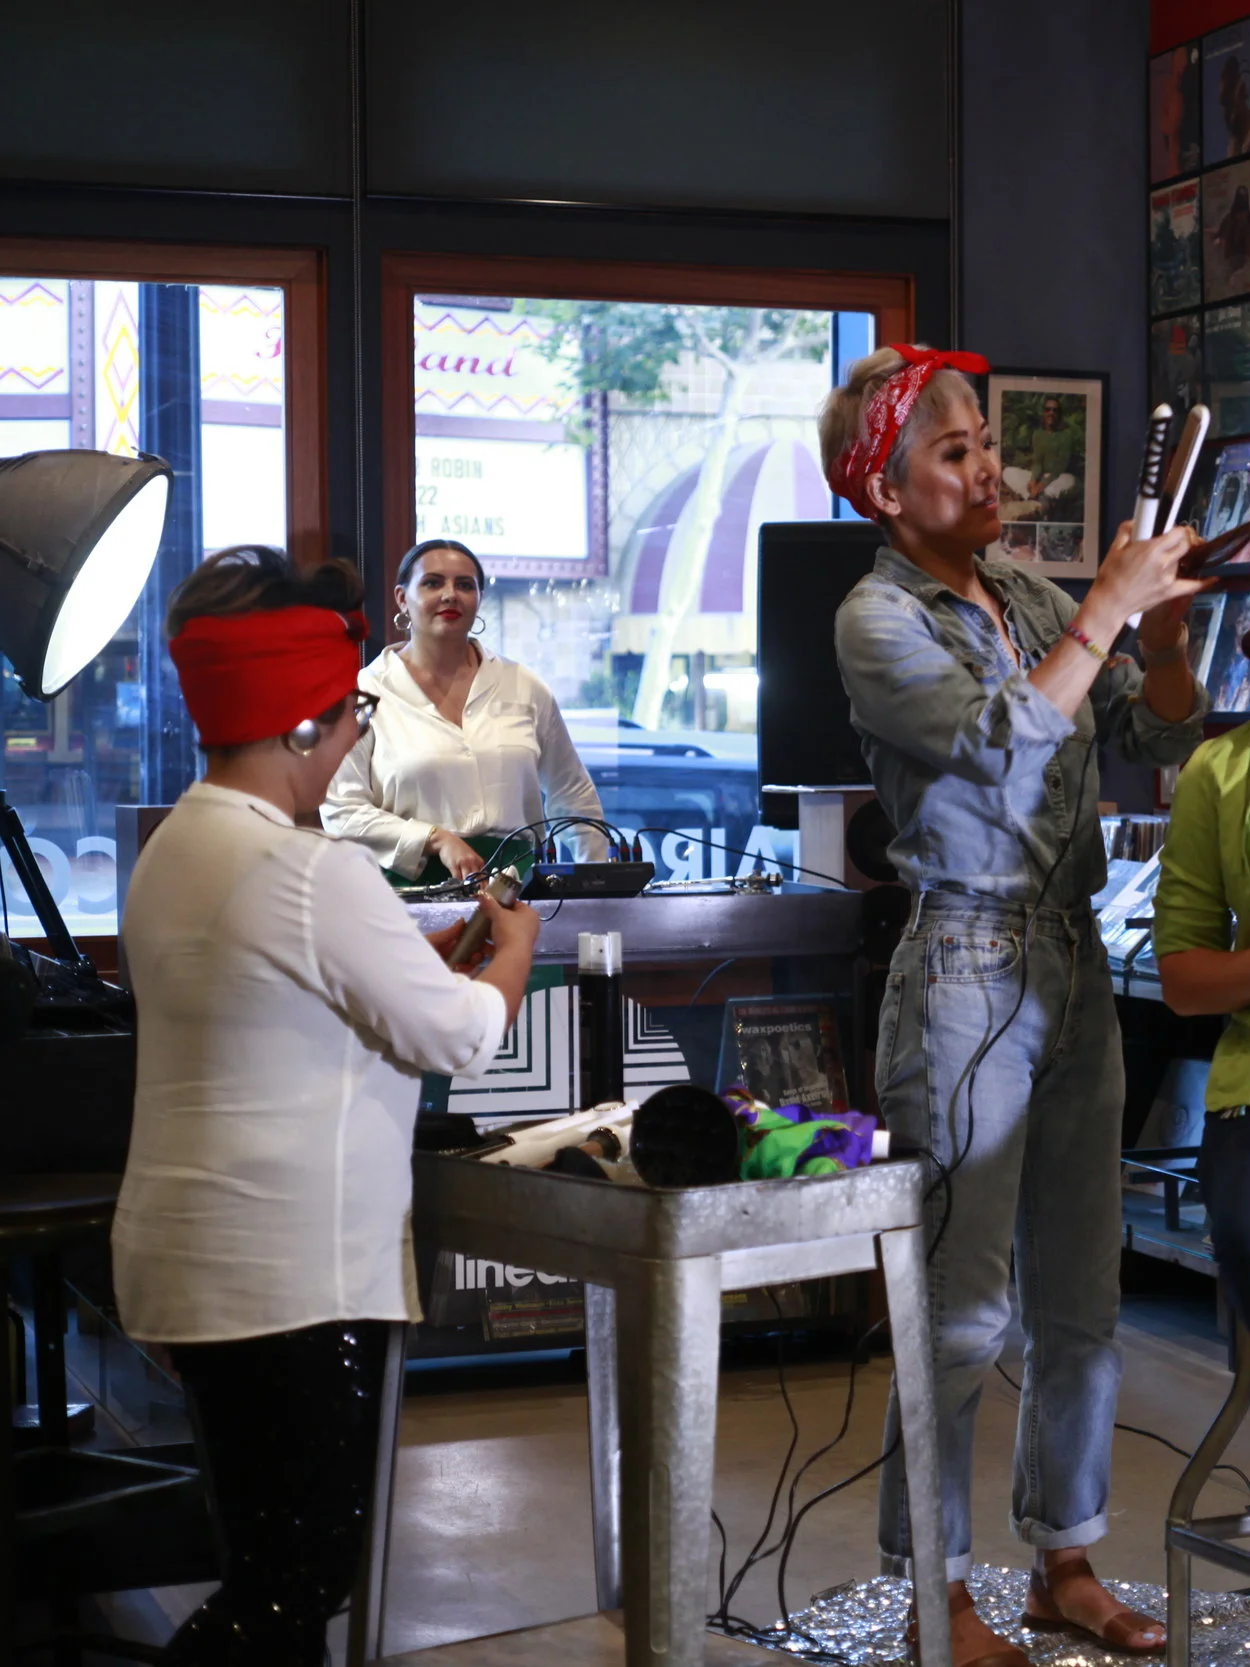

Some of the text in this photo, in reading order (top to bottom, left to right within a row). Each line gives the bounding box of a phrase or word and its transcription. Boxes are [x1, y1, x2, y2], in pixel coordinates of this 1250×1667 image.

[431, 458, 483, 479] ROBIN
[441, 516, 505, 536] ASIANS
[742, 1022, 812, 1036] waxpoetics
[455, 1253, 578, 1290] line
